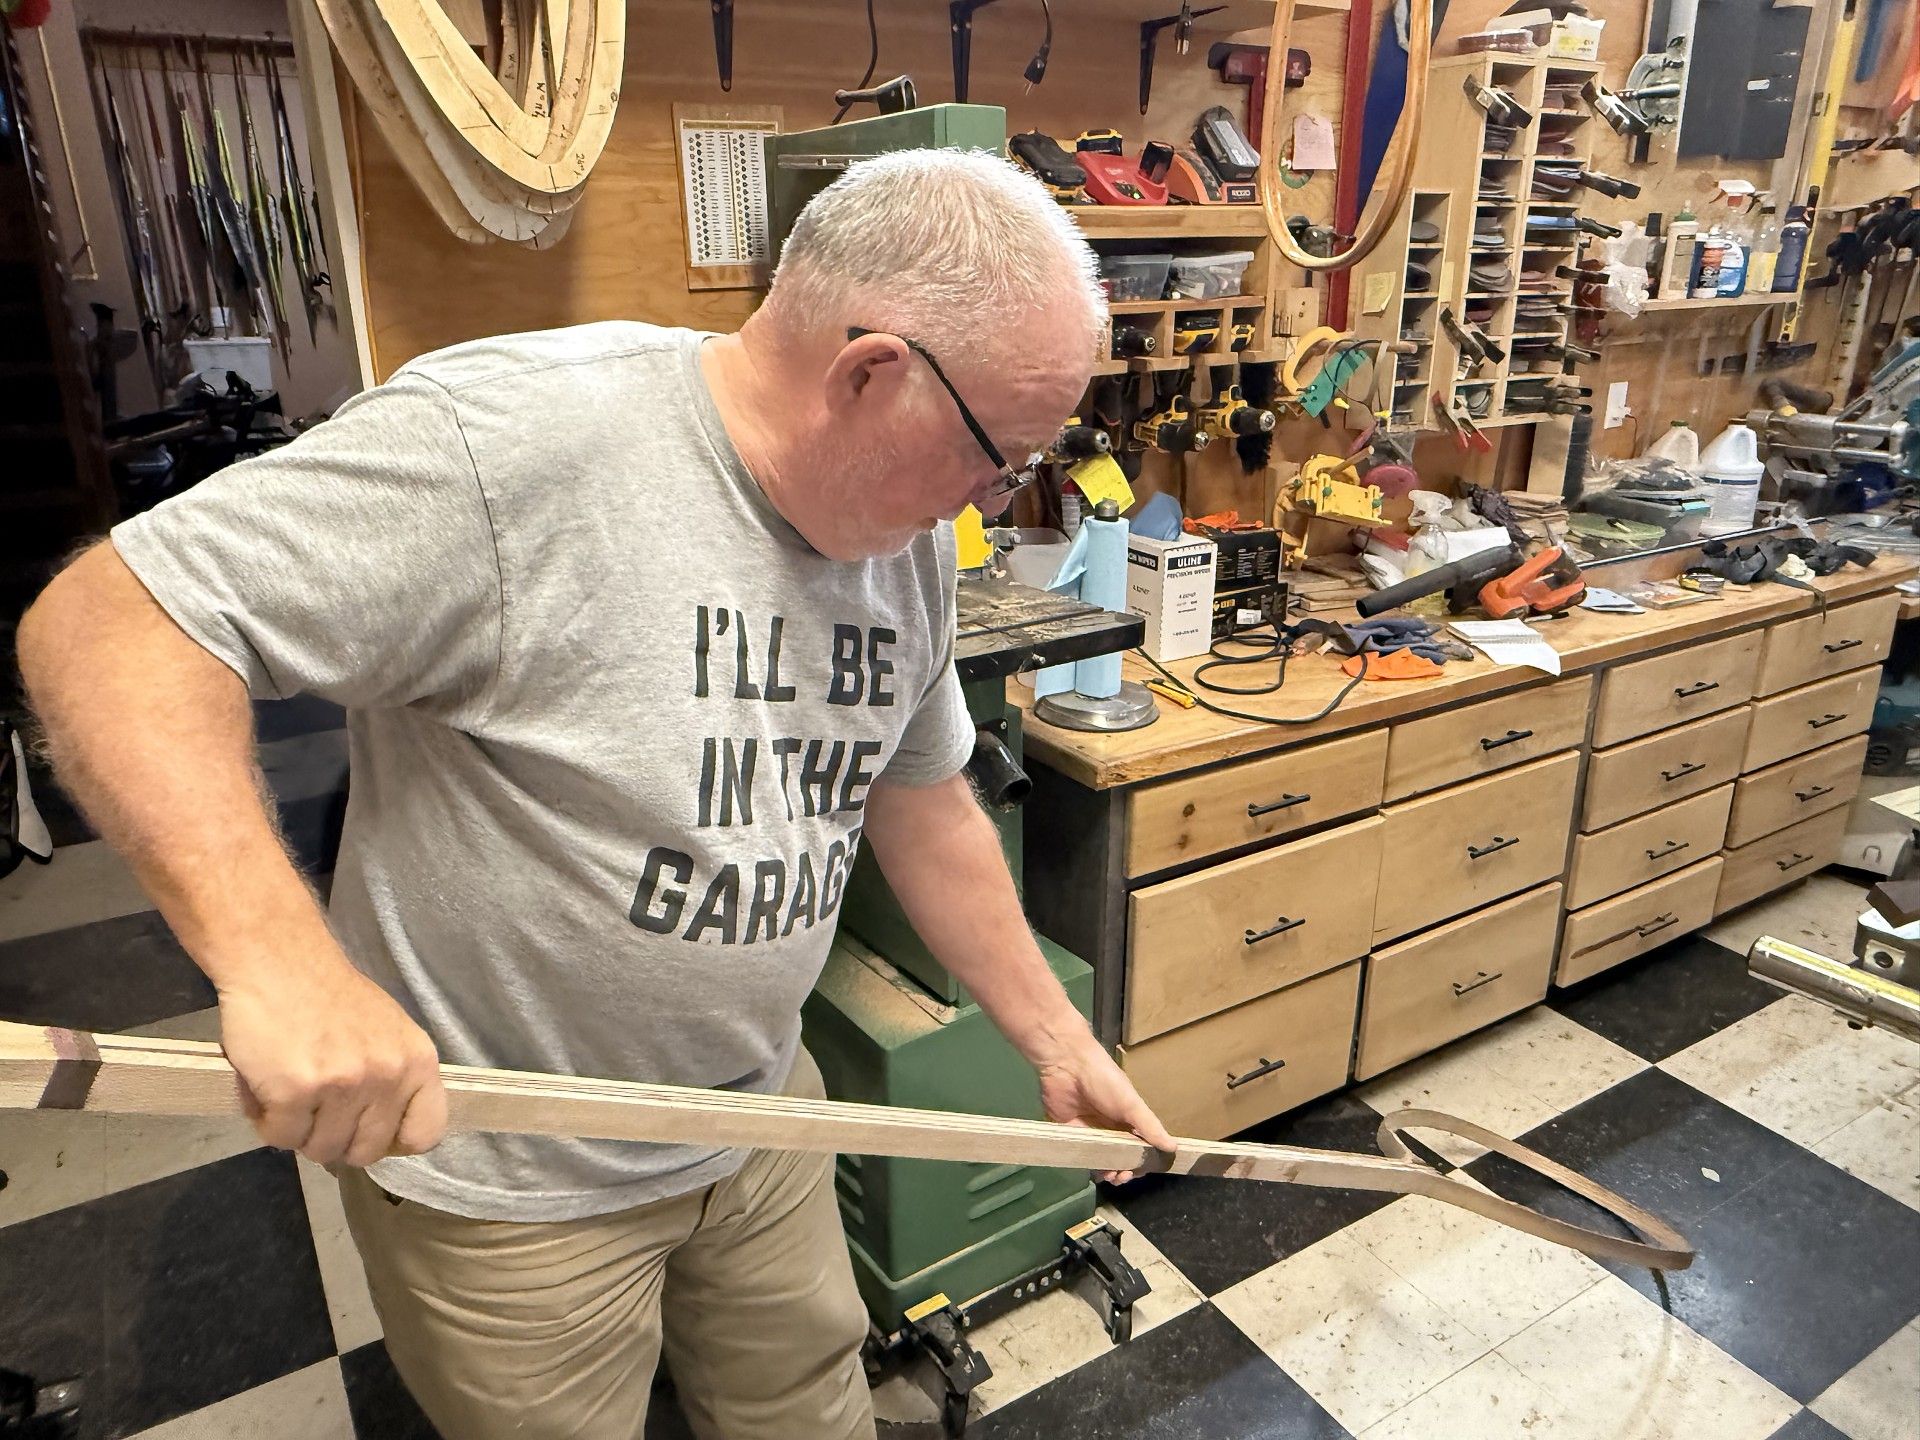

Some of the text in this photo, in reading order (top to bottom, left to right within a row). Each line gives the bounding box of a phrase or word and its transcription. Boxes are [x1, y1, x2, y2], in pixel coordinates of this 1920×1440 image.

[695, 605, 897, 706] I'LL BE
[698, 737, 882, 827] IN THE
